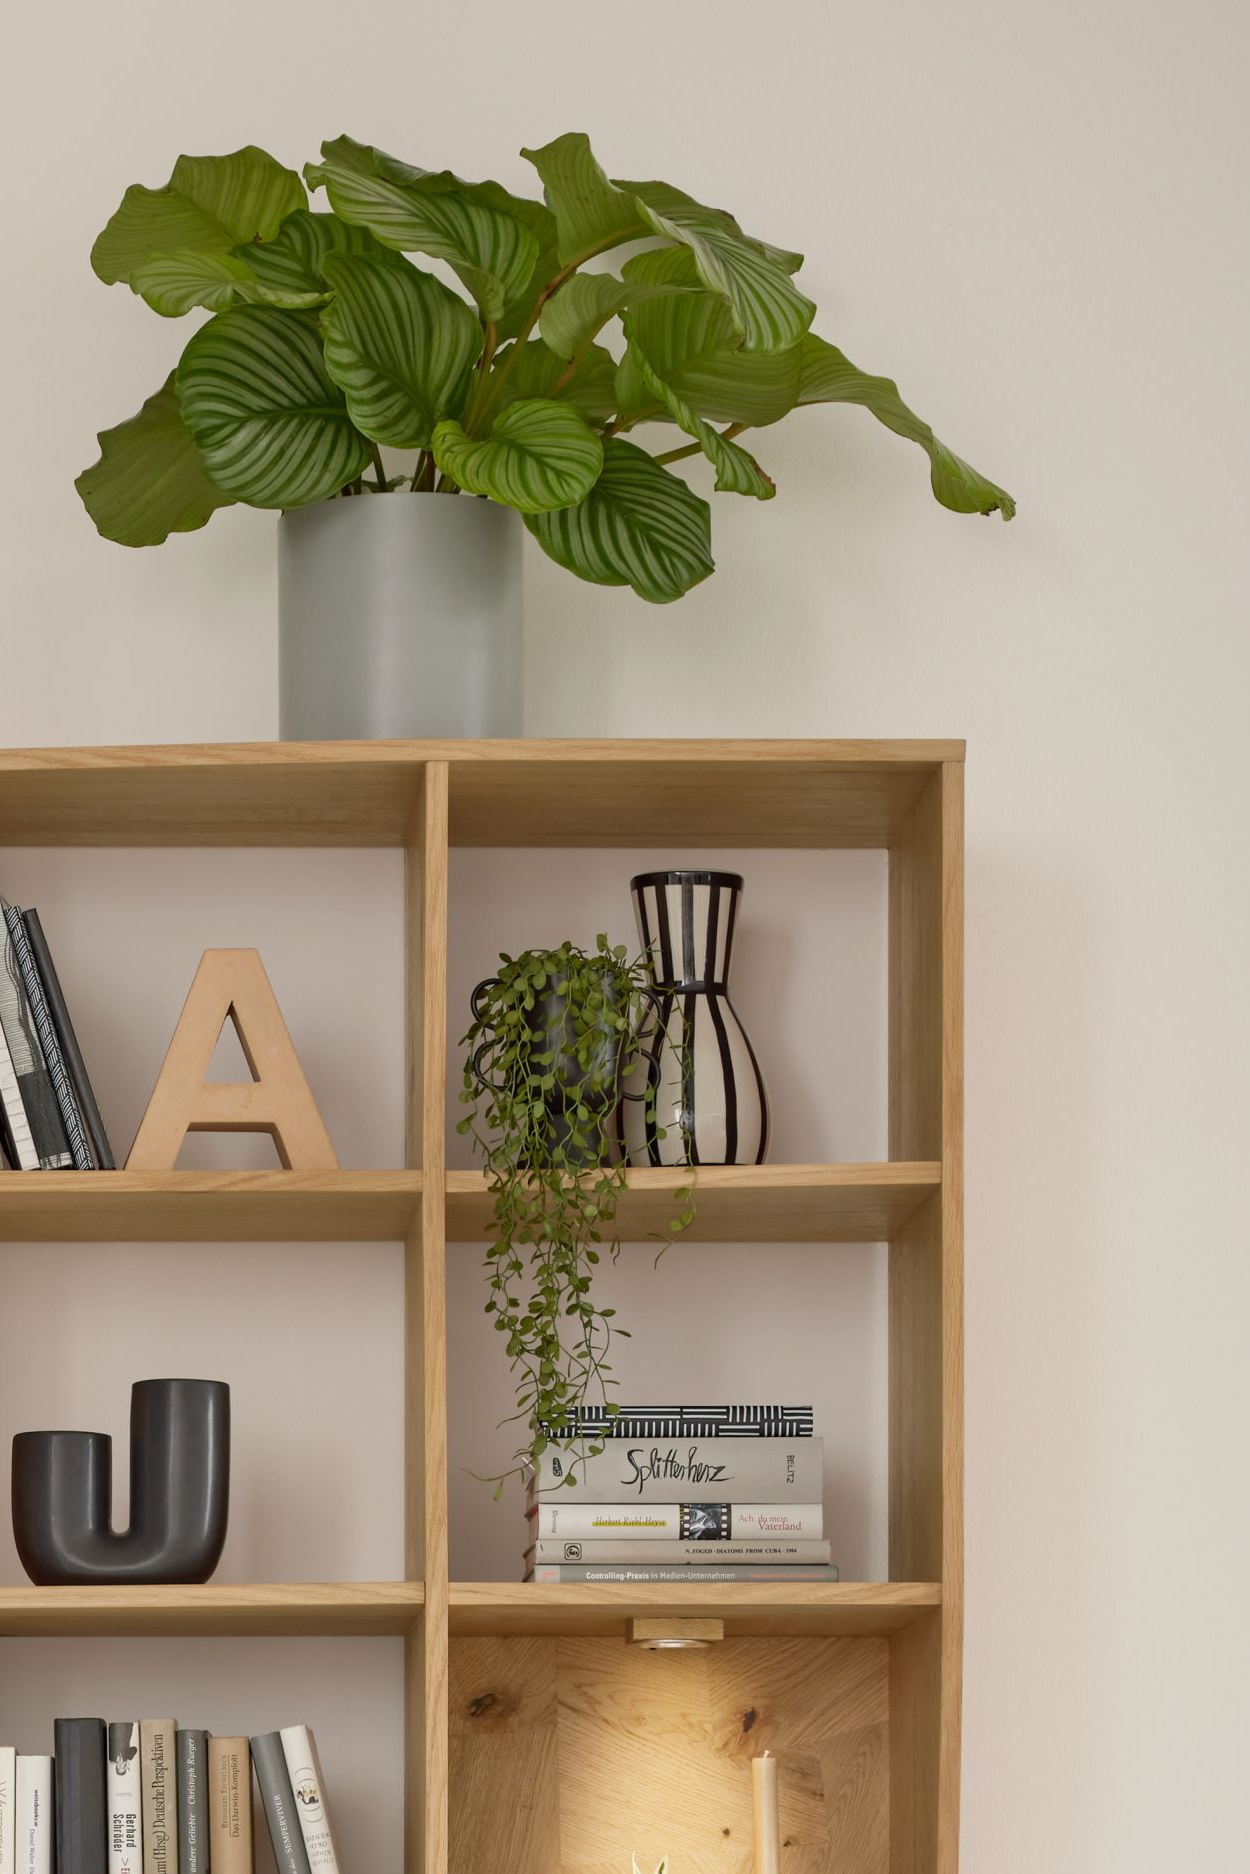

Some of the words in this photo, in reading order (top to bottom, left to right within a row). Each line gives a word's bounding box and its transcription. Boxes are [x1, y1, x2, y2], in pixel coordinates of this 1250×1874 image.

[124, 947, 341, 1171] A
[621, 1446, 735, 1495] Splitterherz
[758, 1521, 802, 1531] Vaterland
[769, 1515, 788, 1523] mein
[586, 1571, 649, 1580] Controlling-Praxis
[660, 1571, 735, 1579] Medien-Unternehmen
[187, 1739, 197, 1765] Rueger
[187, 1768, 198, 1805] Christoph
[231, 1754, 240, 1821] Darwin-Komplott
[113, 1813, 124, 1852] Schröder
[126, 1813, 136, 1848] Gerhard
[188, 1813, 197, 1844] Geliebte
[188, 1847, 197, 1873] andere
